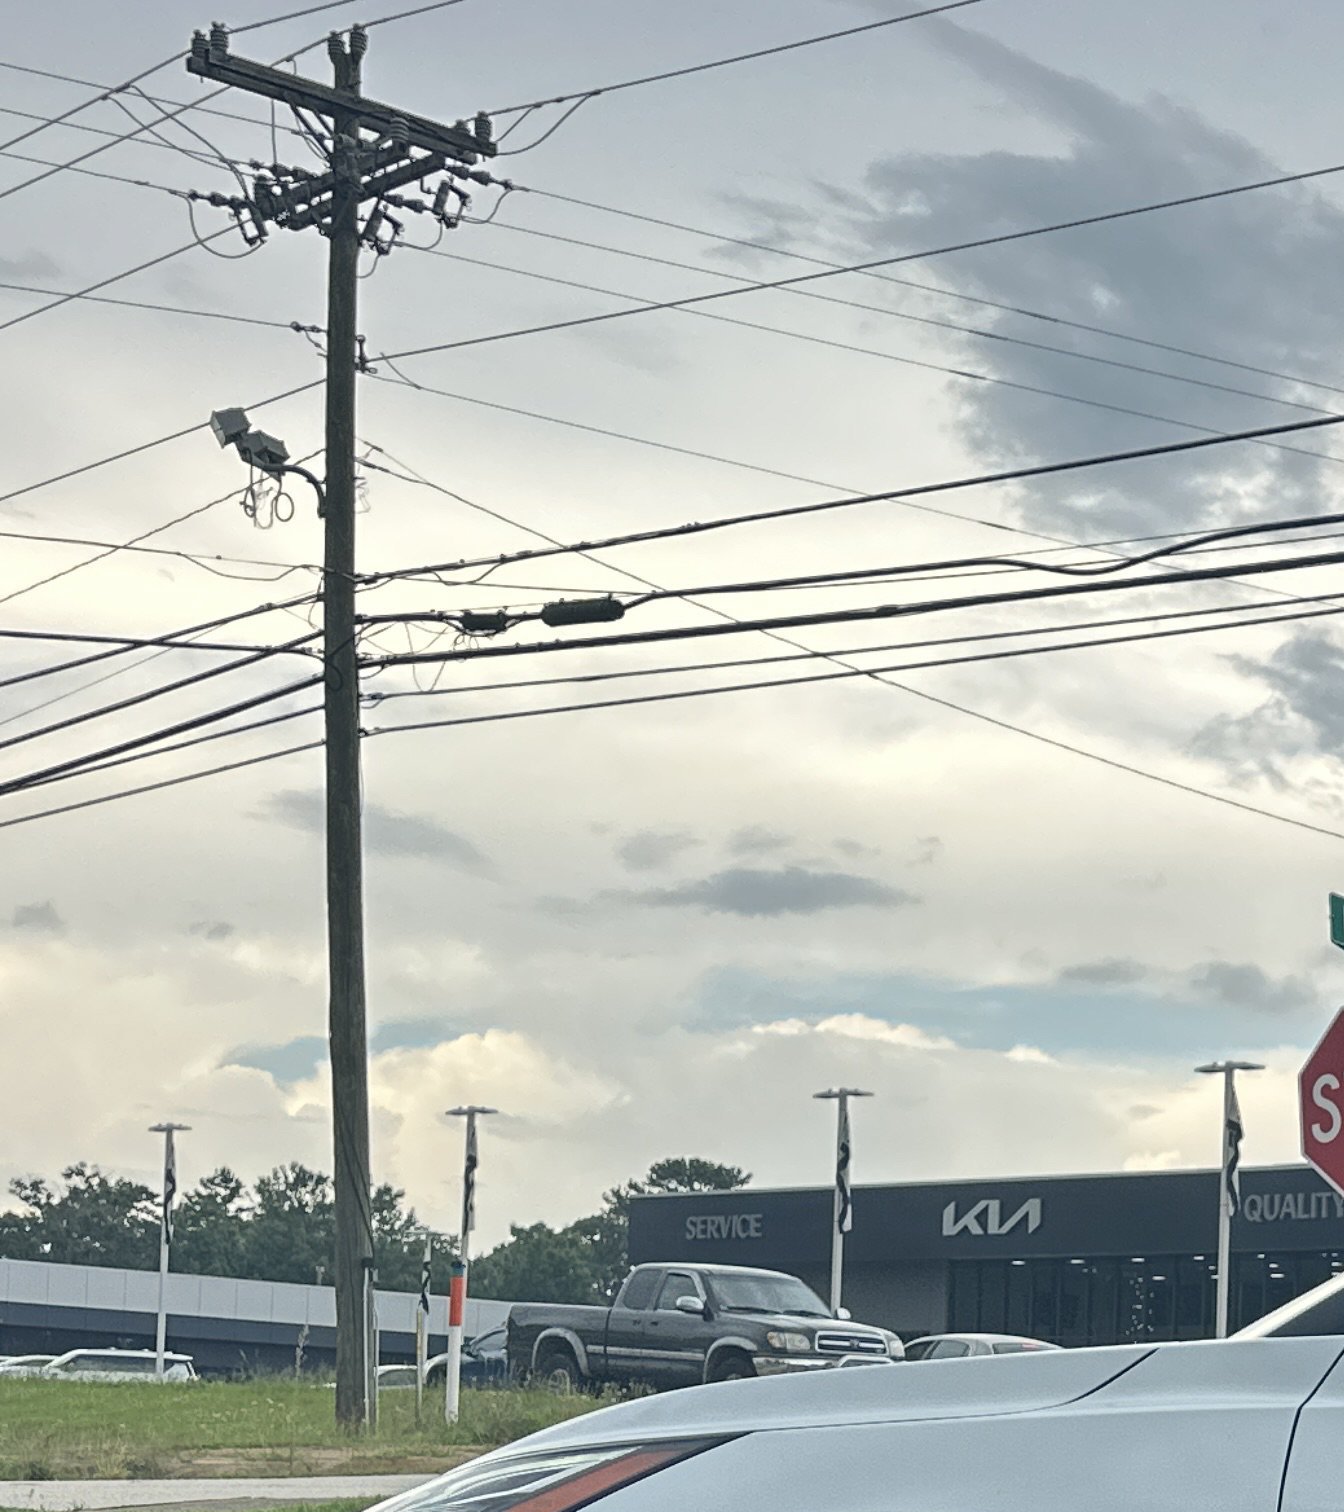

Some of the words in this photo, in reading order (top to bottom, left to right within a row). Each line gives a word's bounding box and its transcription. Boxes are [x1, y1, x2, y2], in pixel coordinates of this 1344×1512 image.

[942, 1198, 1041, 1236] KIA
[1243, 1192, 1344, 1222] QUALITY
[685, 1213, 763, 1240] SERVICE
